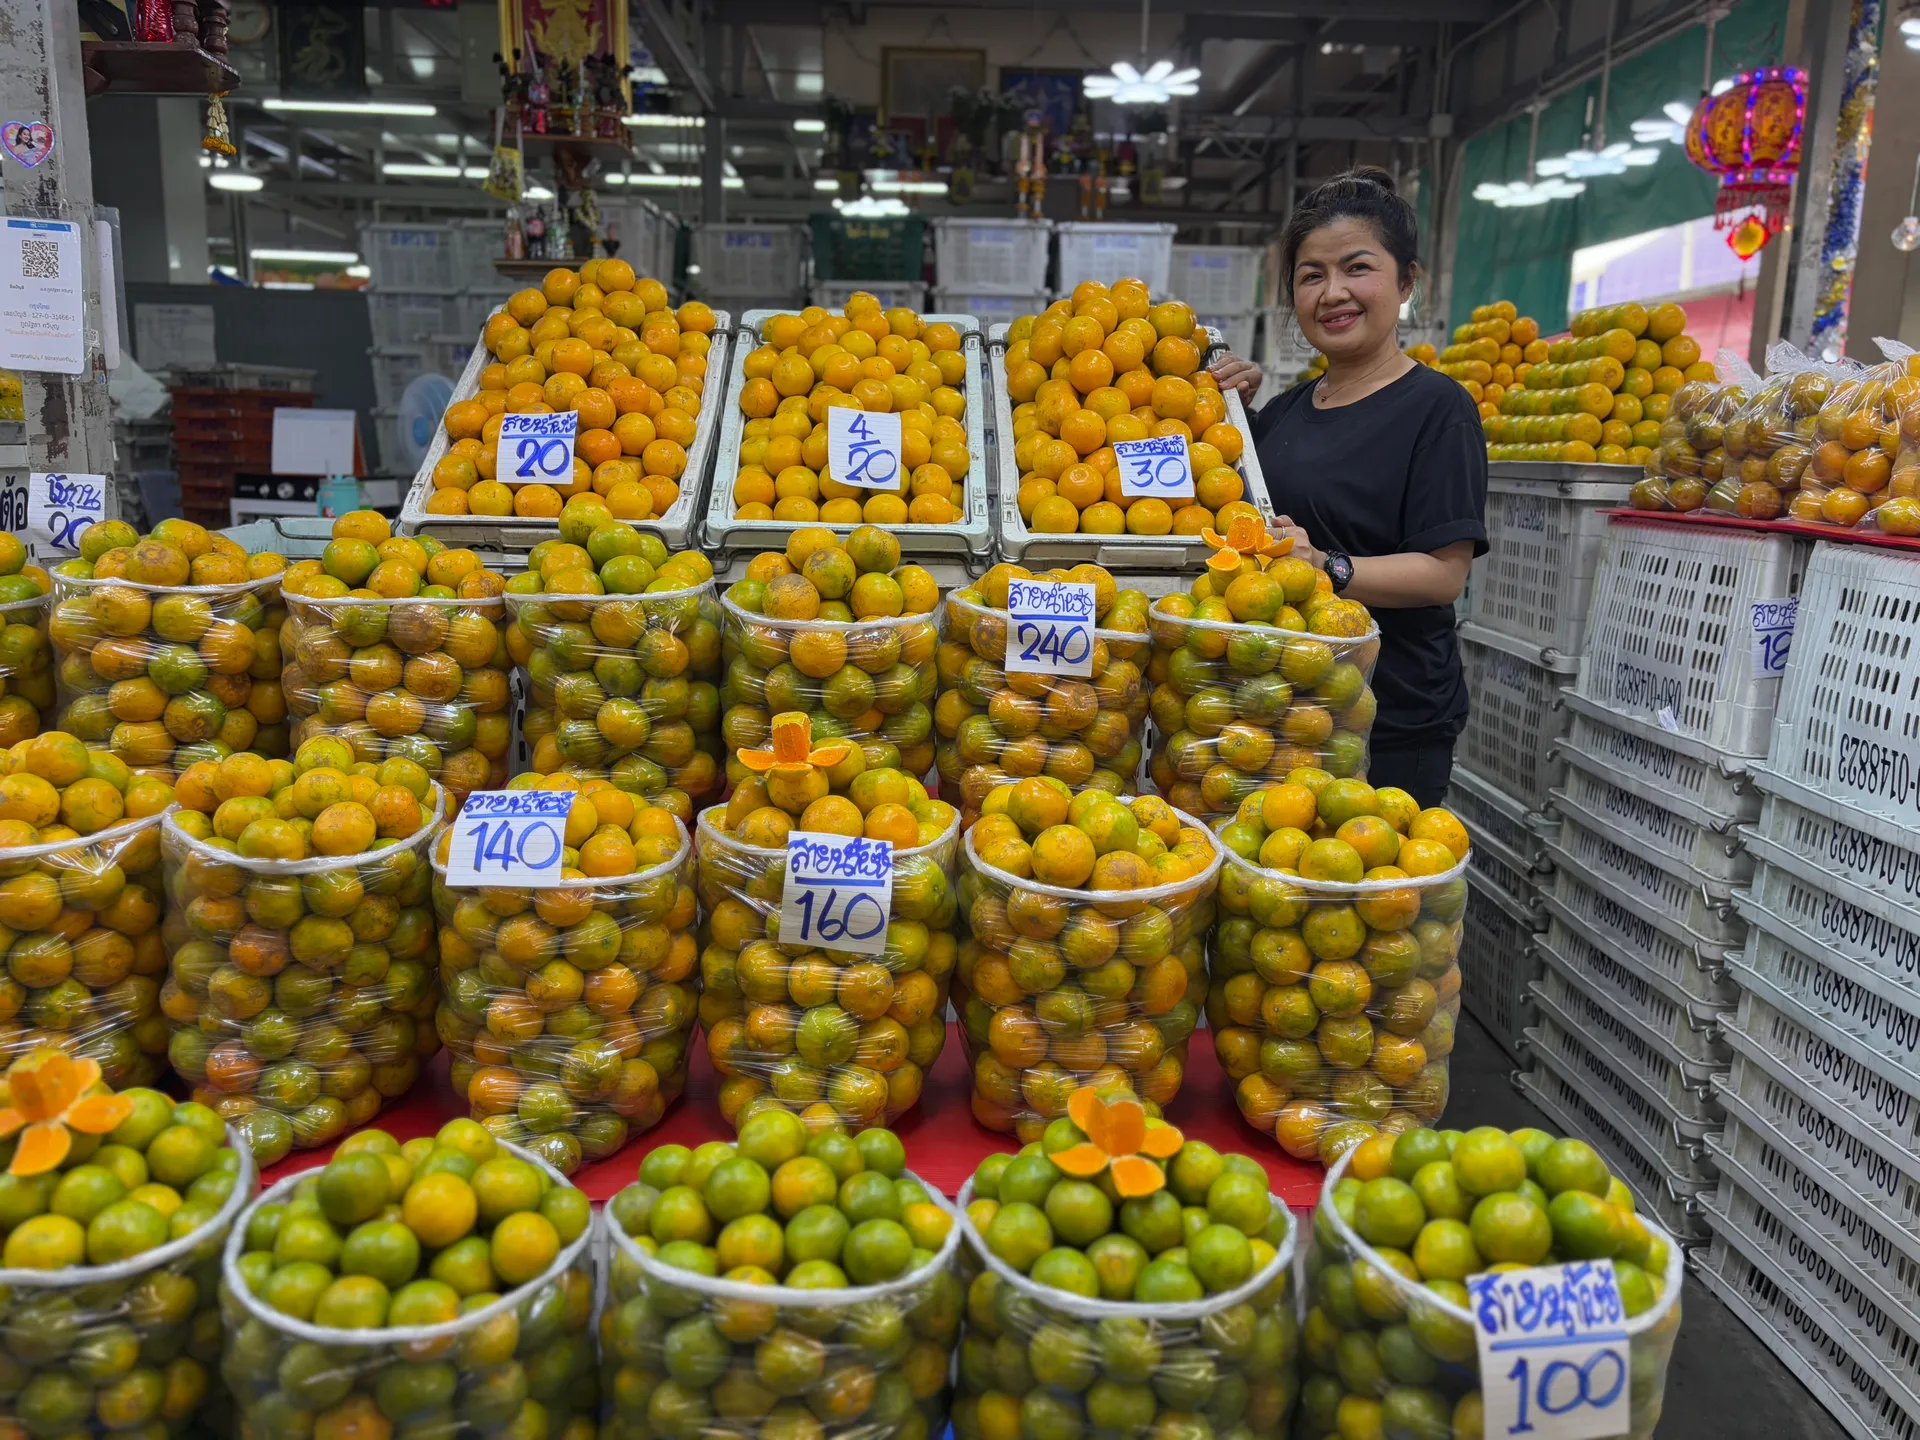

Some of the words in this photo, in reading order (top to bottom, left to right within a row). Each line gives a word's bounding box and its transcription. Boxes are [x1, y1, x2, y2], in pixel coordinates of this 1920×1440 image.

[848, 413, 874, 441] 4
[515, 438, 570, 477] 20
[845, 447, 897, 484] 20
[1129, 456, 1187, 488] 30
[1018, 622, 1091, 667] 240
[1616, 662, 1682, 721] 080-0148823
[466, 820, 561, 873] 140
[794, 888, 885, 942] 160
[1507, 1347, 1626, 1436] 100
